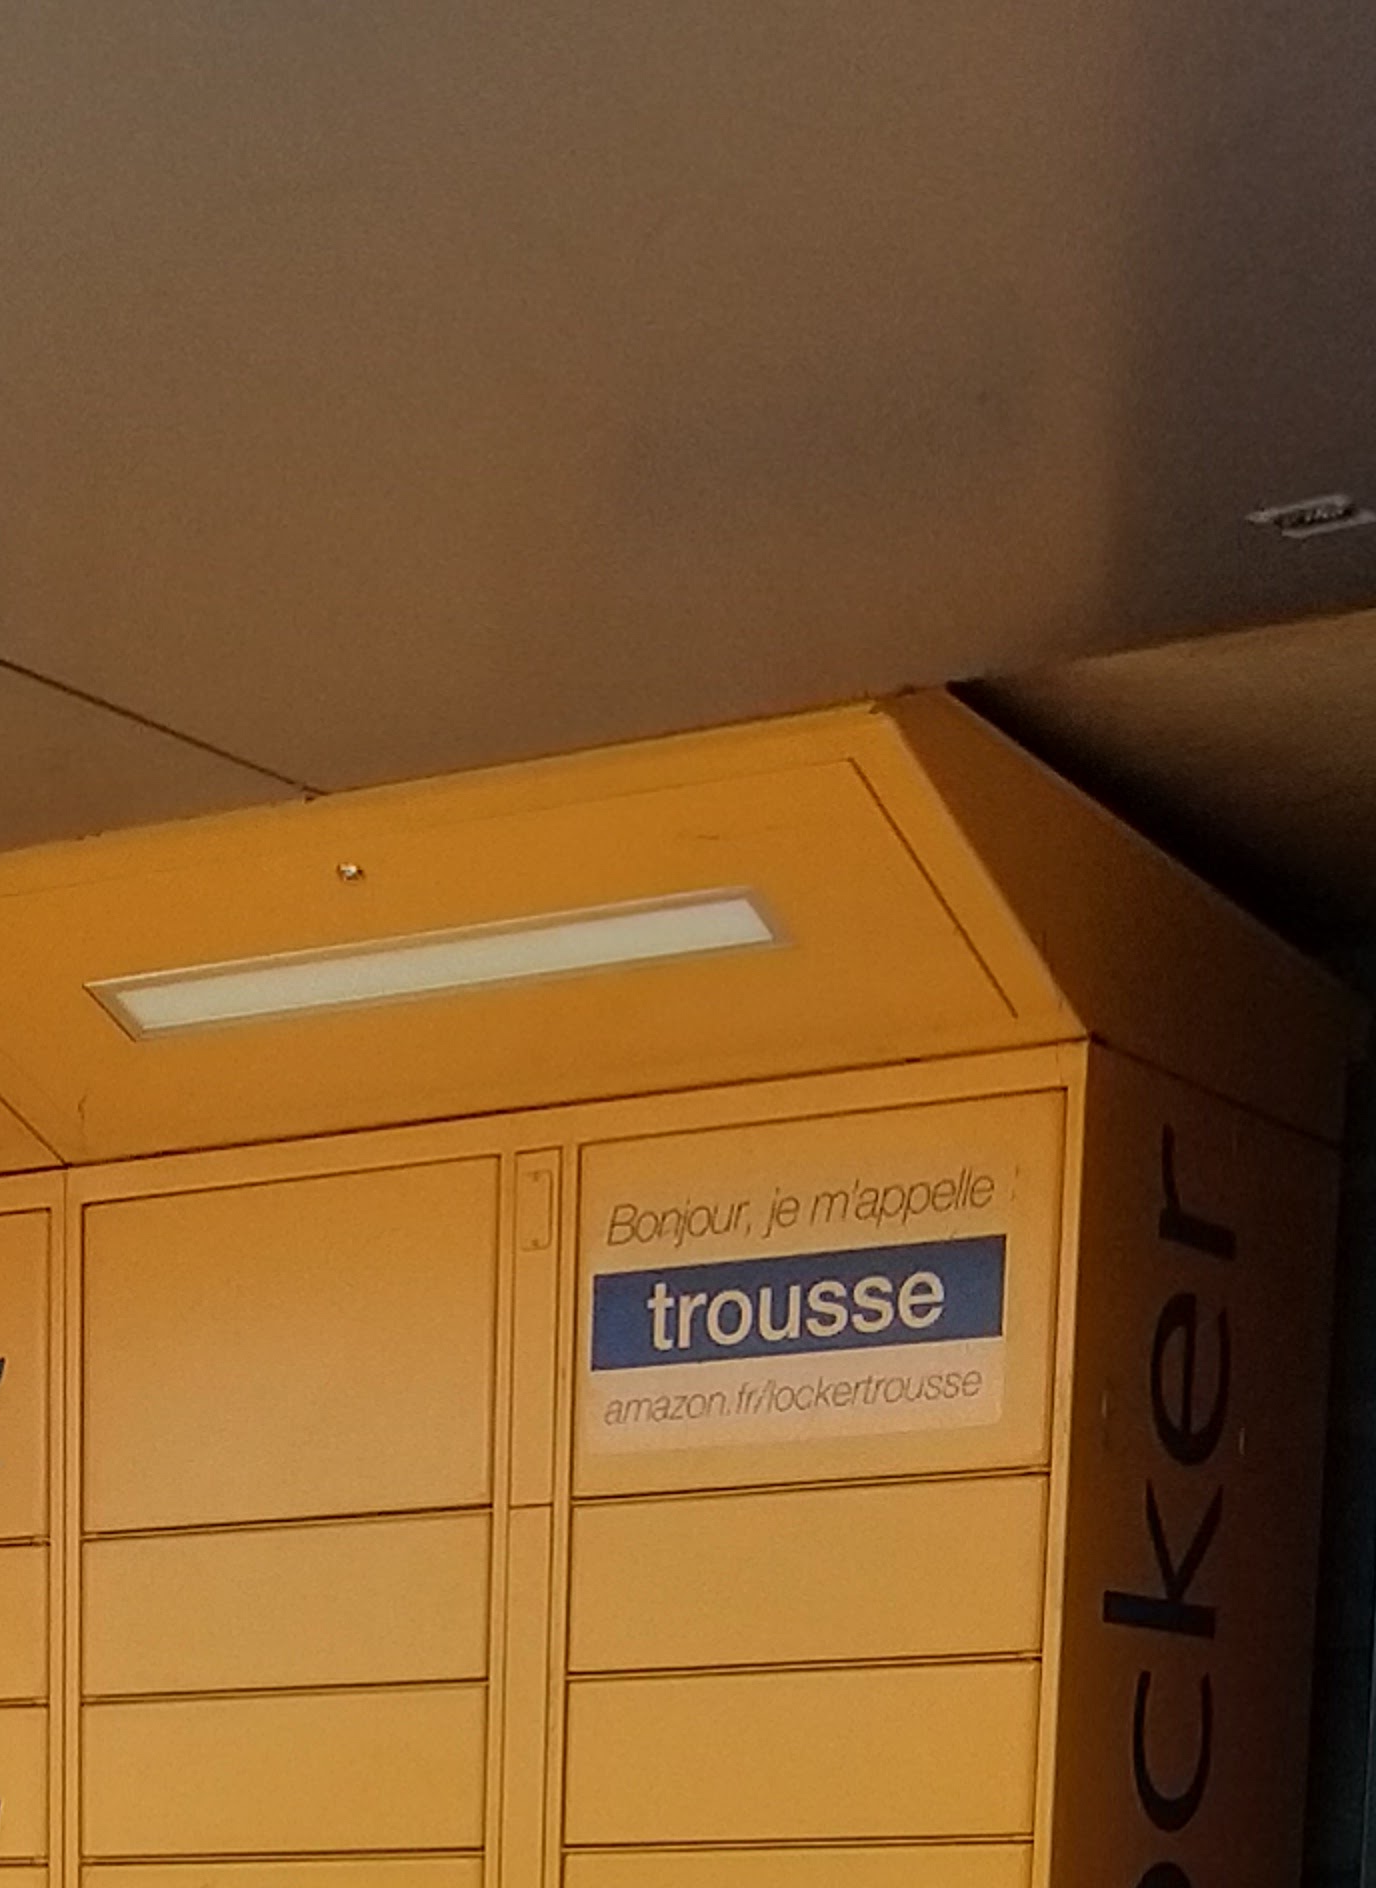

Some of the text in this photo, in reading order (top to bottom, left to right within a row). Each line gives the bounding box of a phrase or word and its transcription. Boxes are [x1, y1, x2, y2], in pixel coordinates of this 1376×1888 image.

[607, 1167, 995, 1249] Bonjour, je m'appelle
[647, 1270, 945, 1351] trousse
[603, 1369, 983, 1426] amazon.fr/lockertrousse
